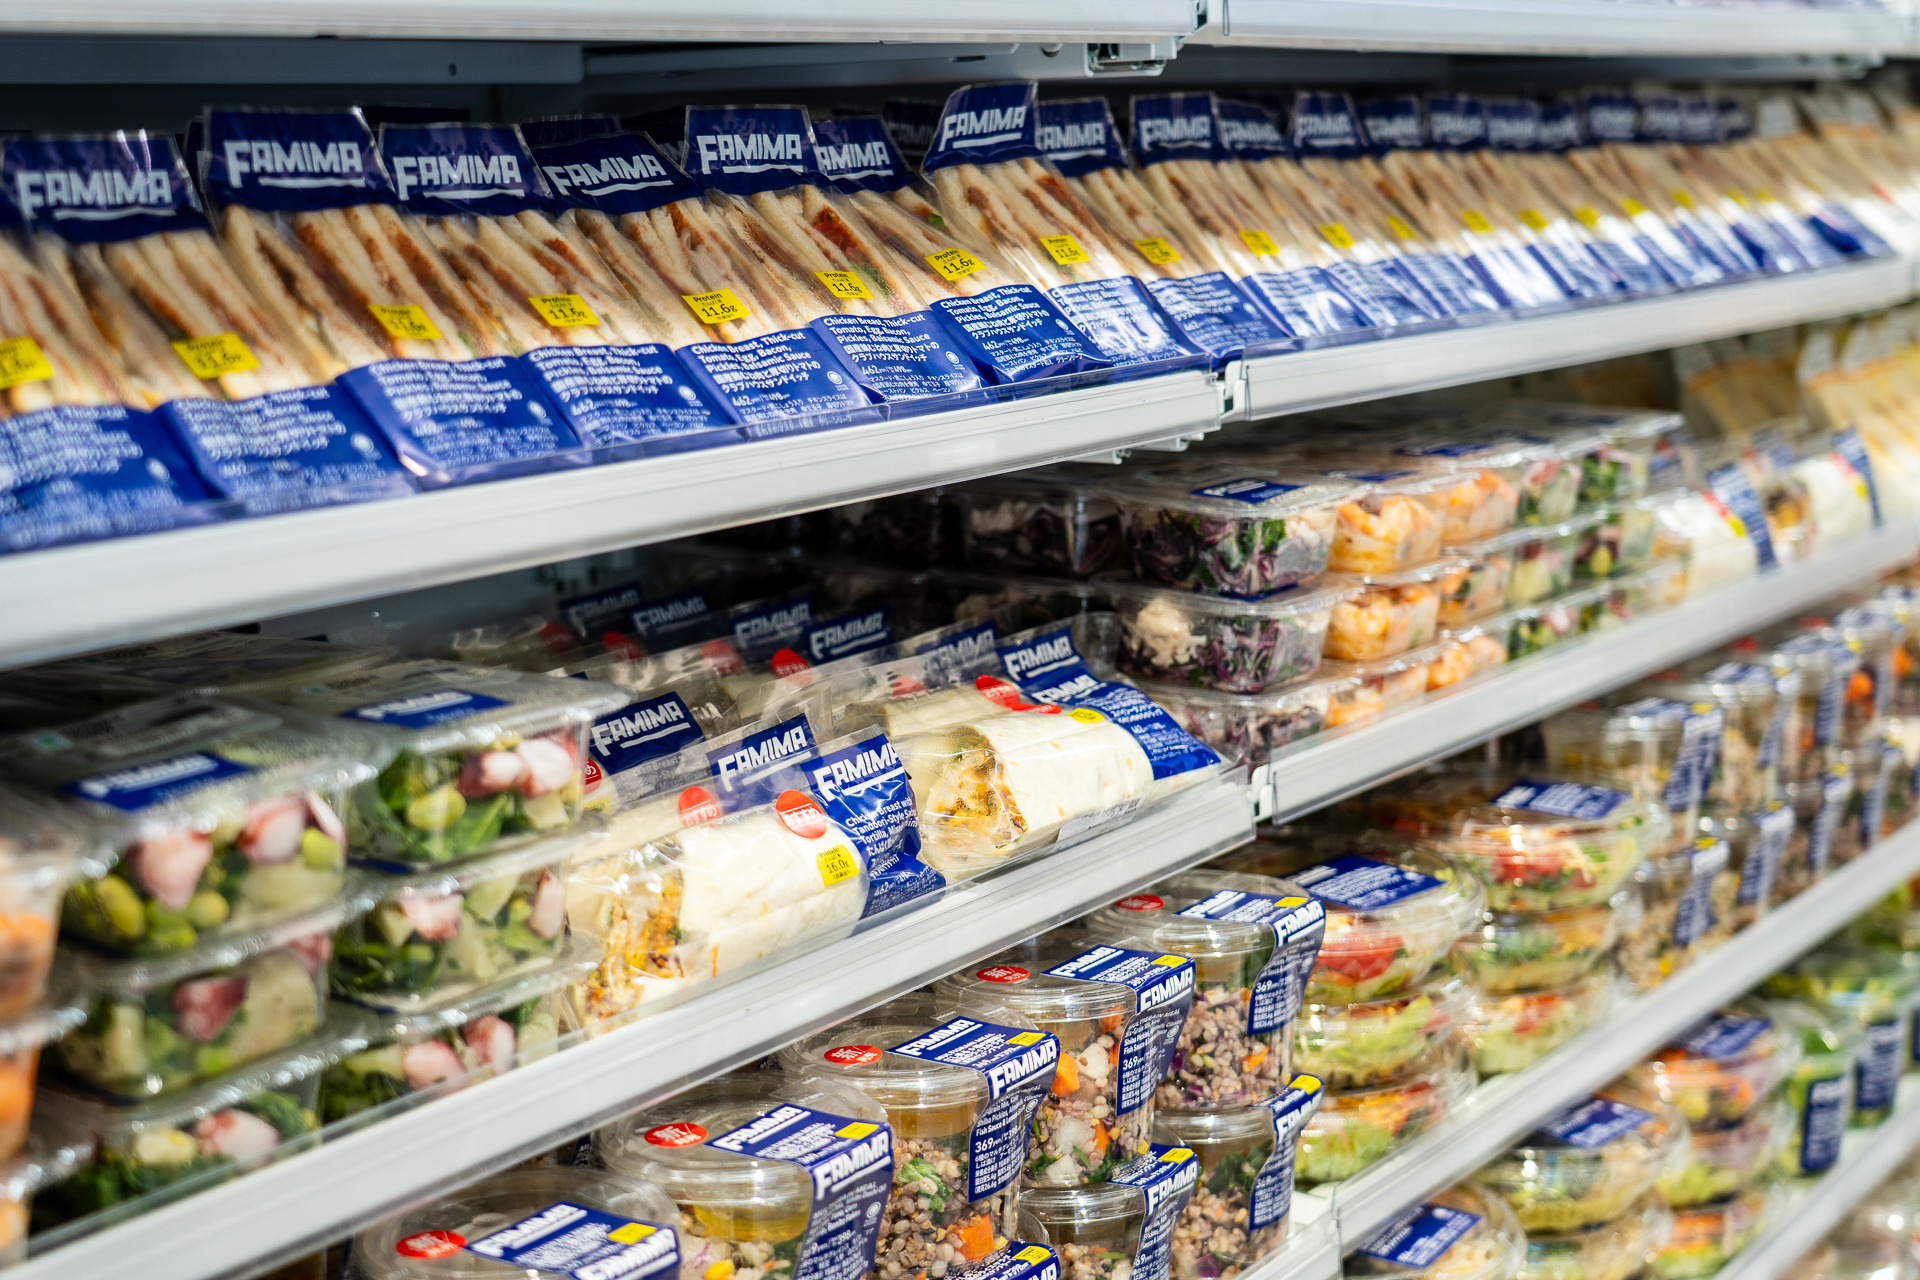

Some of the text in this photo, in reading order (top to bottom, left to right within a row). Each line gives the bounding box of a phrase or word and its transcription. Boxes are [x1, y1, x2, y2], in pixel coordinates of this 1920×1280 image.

[938, 105, 1027, 152] FAMIMA
[1138, 115, 1212, 151] FAMIMA
[223, 139, 365, 190] FAMIMA
[696, 133, 803, 175] FAMIMA
[392, 154, 523, 201] FAMIMA
[540, 153, 668, 197] FAMIMA
[17, 169, 173, 221] FAMIMA
[934, 250, 959, 262] Protein
[1055, 247, 1081, 258] 11.6g
[942, 258, 975, 274] 11.6g
[692, 292, 723, 303] Protein
[832, 282, 862, 294] 11.6g
[940, 287, 1032, 310] Chicken Breast, Thick-cut
[541, 296, 573, 304] Protein
[701, 303, 737, 317] 11.6g
[947, 296, 1024, 317] Tomato, Egg, Bacon,
[549, 307, 587, 320] 11.6g
[823, 313, 926, 328] Chicken Breast, Thick-cut
[955, 302, 1041, 324] Pickles, Balsamic Sauce
[829, 326, 911, 336] Tomato, Egg, Bacon,
[836, 333, 931, 344] Pickles, Balsamic Sauce
[972, 319, 1043, 340] クラブハウスサンドイッチ
[529, 345, 659, 363] Chicken Breast, Thick-cut
[691, 332, 806, 355] Chicken Breast, Thick-cut
[698, 344, 792, 365] Tomato, Egg, Bacon,
[535, 357, 583, 372] Tomato,
[606, 355, 640, 366] Bacon,
[705, 351, 812, 374] Pickles, Balsamic Sauce
[852, 352, 927, 363] クラブハウスサンドイッチ
[543, 365, 664, 381] Pickles, Balsamic Sauce
[722, 372, 810, 394] クラブハウスサンドイッチ
[733, 602, 811, 649] FAMIMA
[809, 610, 884, 660] FAMIMA
[1003, 634, 1072, 682] FAMIMA
[1031, 673, 1099, 705] FAMIMA
[590, 699, 686, 757] FAMIMA
[717, 725, 808, 792] FAMIMA
[812, 741, 902, 802] FAMIMA
[684, 802, 718, 827] おすすめ
[879, 801, 902, 815] Breast
[901, 796, 913, 808] with
[781, 806, 821, 830] おすすめ
[852, 813, 905, 836] Tandoori-Style
[860, 829, 889, 845] Tortilla,
[819, 847, 840, 858] Protein
[826, 860, 850, 873] 16.0g
[1272, 899, 1325, 948] FAMIMA
[982, 967, 1013, 979] 新
[1049, 946, 1117, 978] FAMIMA
[1139, 965, 1194, 1014] FAMIMA
[895, 1018, 976, 1057] FAMIMA
[1124, 1037, 1136, 1046] Shiba
[830, 1047, 863, 1060] 新
[1124, 1046, 1133, 1055] Fish
[988, 1037, 1058, 1101] FAMIMA
[652, 1124, 688, 1141] 新
[712, 1105, 803, 1151] FAMIMA
[976, 1128, 988, 1137] Fish
[988, 1122, 1002, 1133] Sauce
[977, 1117, 992, 1127] Shiba
[813, 1130, 890, 1201] FAMIMA
[976, 1156, 996, 1169] しば漬け
[855, 1180, 876, 1194] MEAL
[862, 1183, 886, 1199] Dashi Oil
[1146, 1160, 1199, 1217] FAMIMA
[470, 1203, 580, 1257] FAMIMA
[828, 1209, 861, 1231] Bonito Flakes
[573, 1227, 677, 1280] FAMIMA
